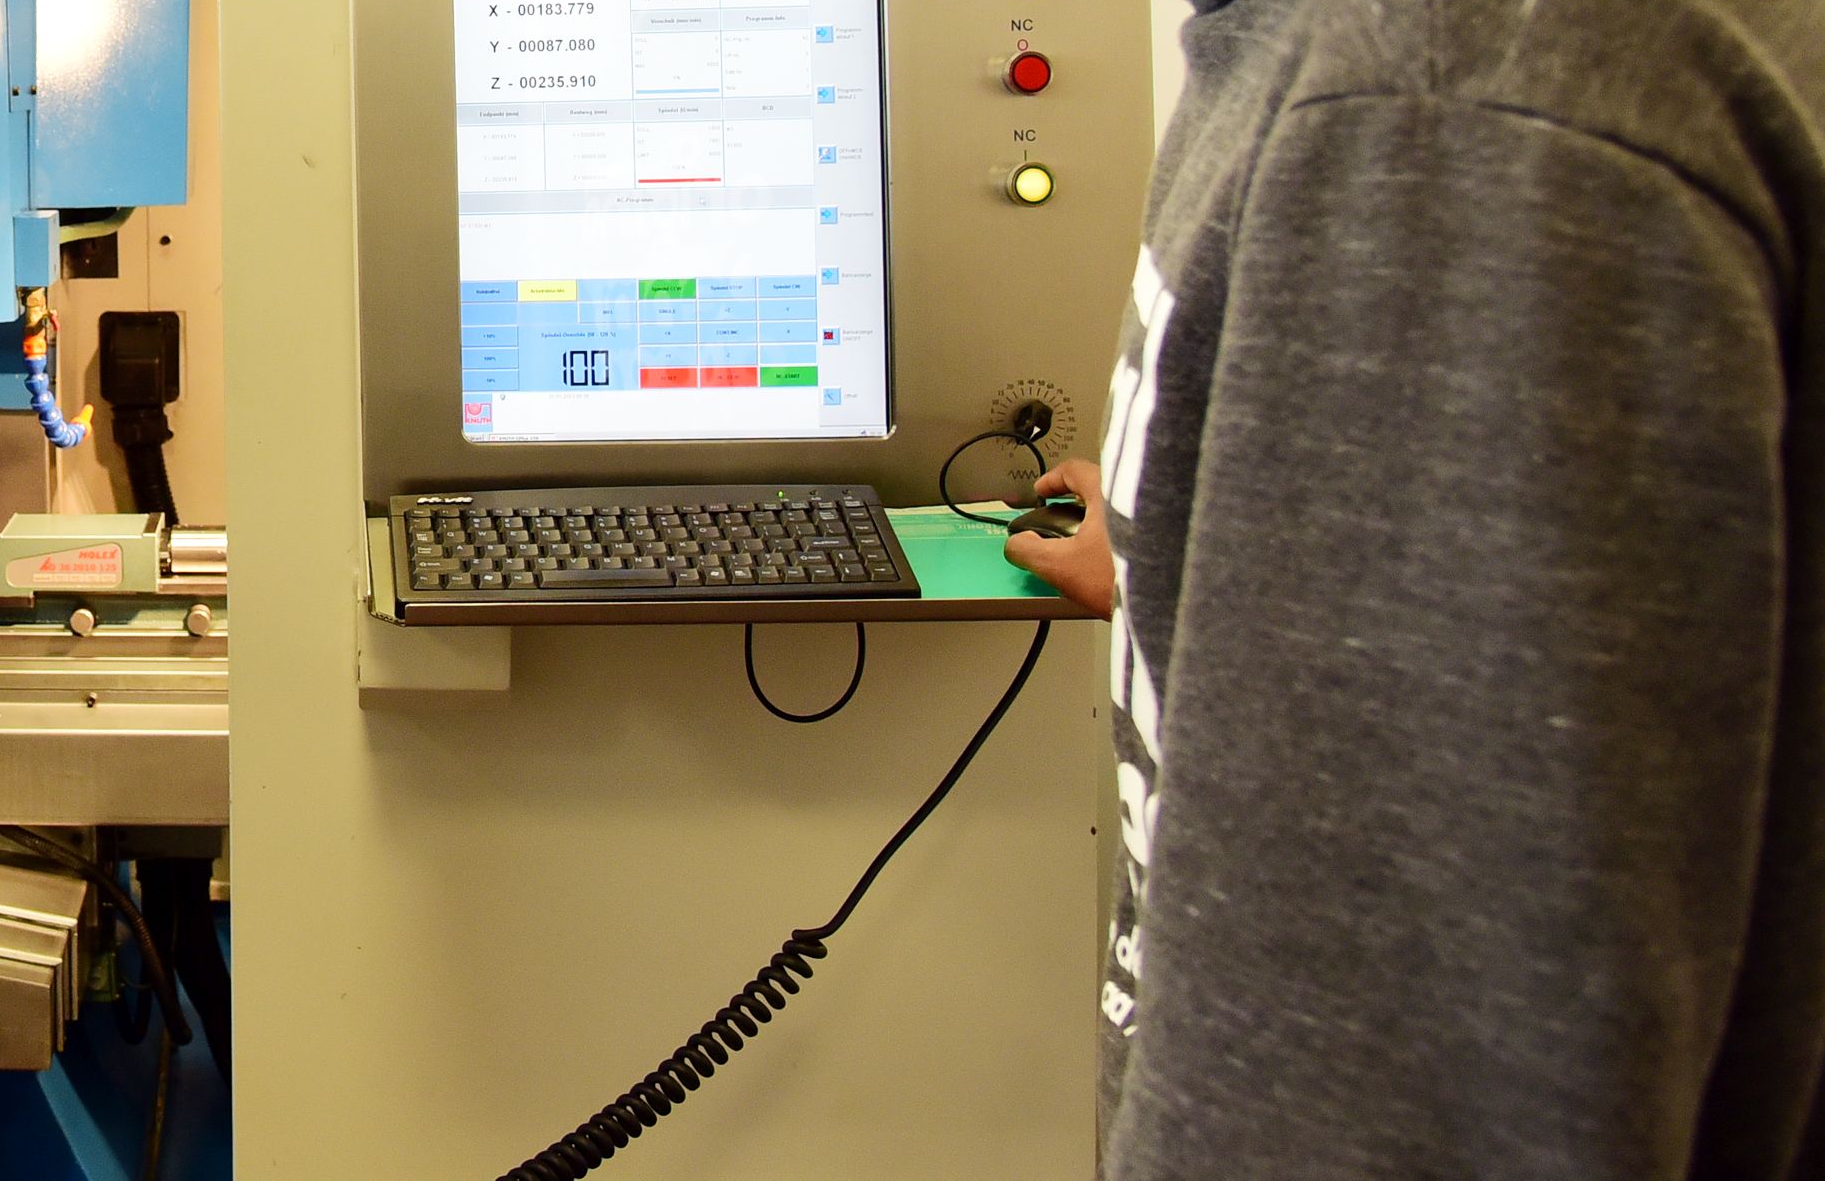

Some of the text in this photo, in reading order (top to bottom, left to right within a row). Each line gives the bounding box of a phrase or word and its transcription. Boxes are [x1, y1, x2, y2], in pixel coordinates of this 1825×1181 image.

[489, 5, 498, 17] X
[518, 3, 595, 16] 00183.779
[1011, 19, 1033, 31] NC
[490, 41, 499, 53] Y
[519, 39, 596, 52] 00087.080
[491, 77, 501, 89] Z
[520, 75, 597, 89] 00235.910
[1014, 129, 1036, 142] NC
[563, 350, 610, 386] 100
[79, 547, 119, 559] HOLEX
